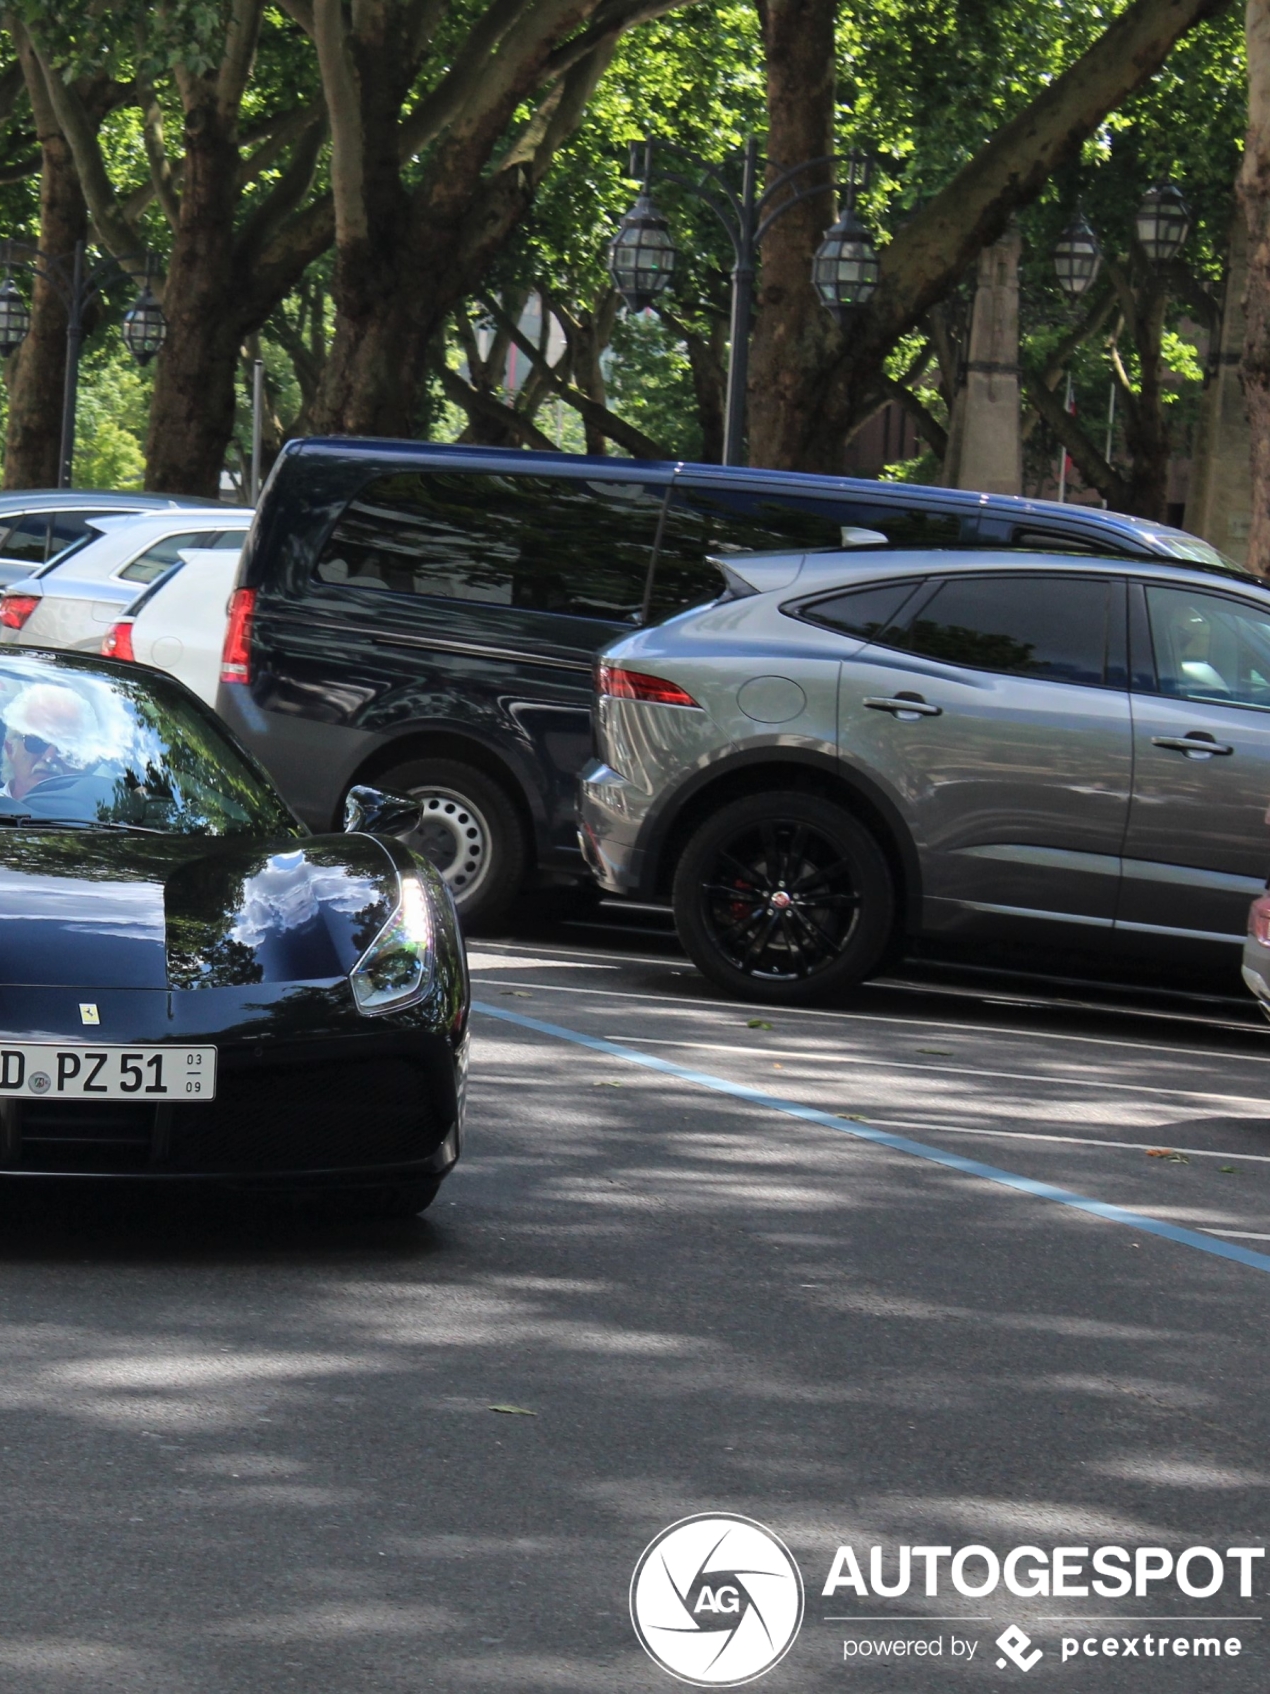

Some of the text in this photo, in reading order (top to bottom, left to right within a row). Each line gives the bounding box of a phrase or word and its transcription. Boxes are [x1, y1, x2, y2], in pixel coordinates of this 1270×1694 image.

[186, 1053, 202, 1065] 03
[0, 1050, 168, 1093] D PZ 51
[185, 1081, 202, 1093] 09
